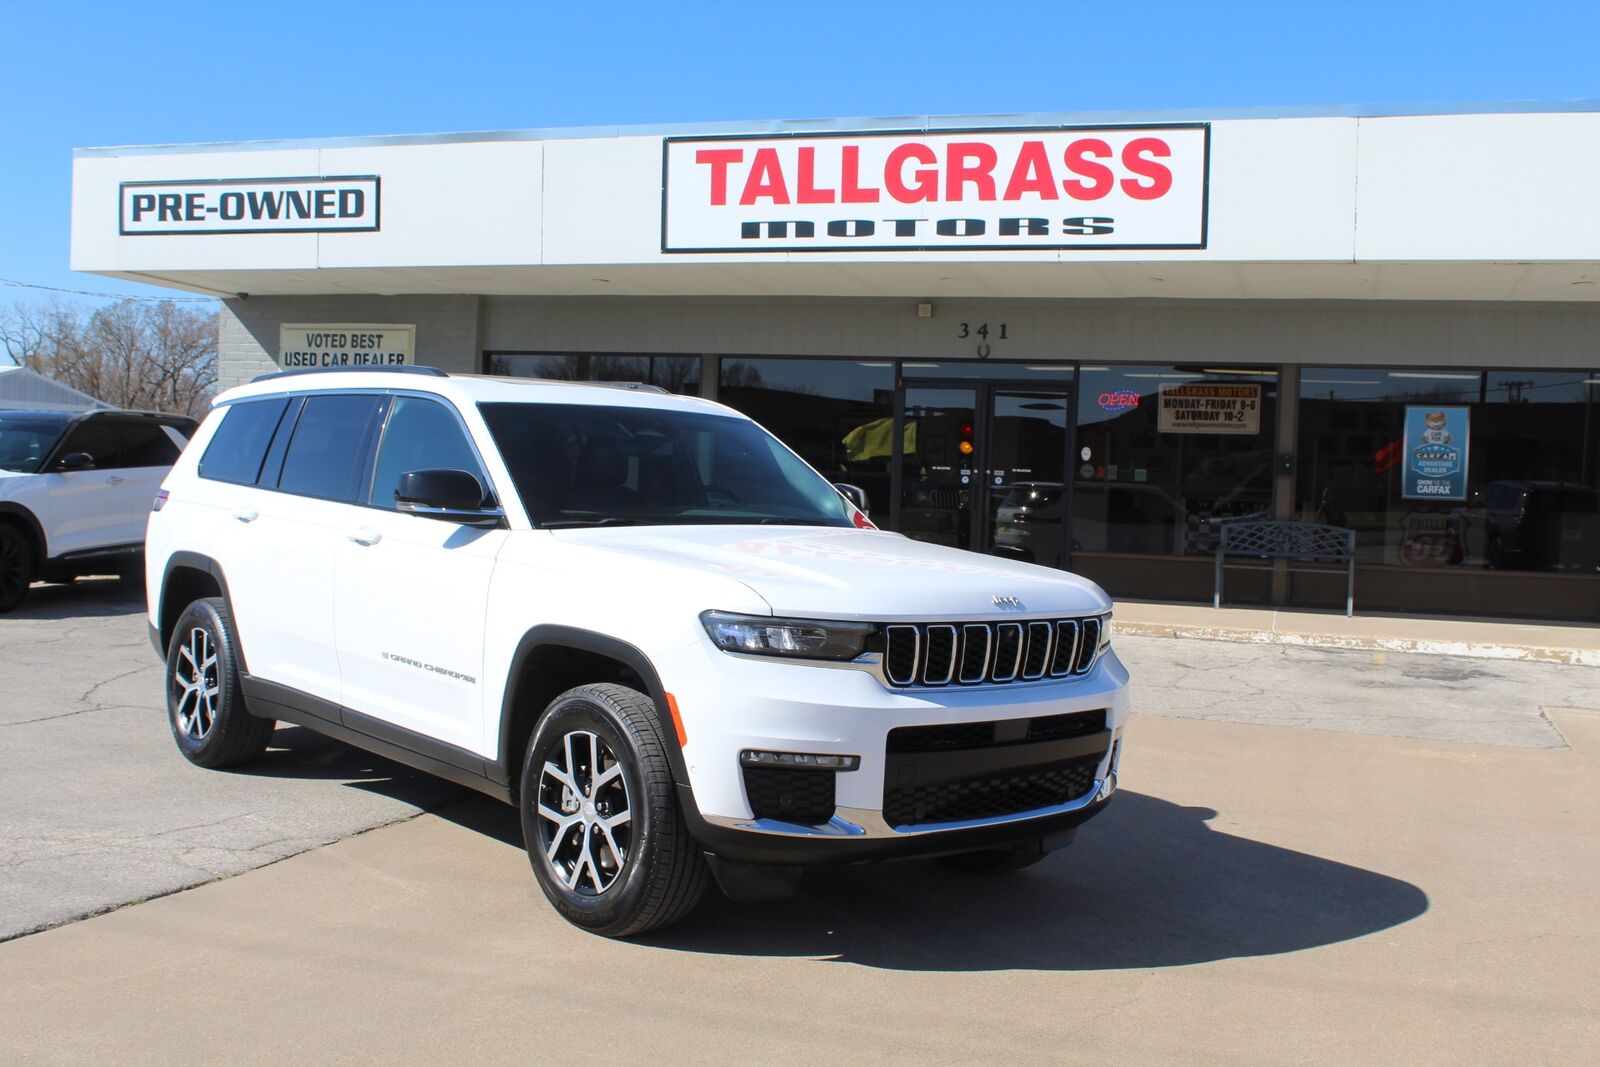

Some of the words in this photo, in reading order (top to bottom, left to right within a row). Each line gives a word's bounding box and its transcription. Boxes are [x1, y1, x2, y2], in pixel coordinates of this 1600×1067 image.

[695, 137, 1173, 206] TALLGRASS
[132, 189, 365, 222] PRE-OWNED
[957, 322, 1008, 340] 341
[306, 333, 347, 348] VOTED
[350, 334, 383, 349] BEST
[284, 352, 317, 366] USED
[321, 353, 349, 367] CAR
[353, 353, 405, 366] DEALER
[1164, 386, 1217, 397] TALLGRASS
[1219, 388, 1257, 398] MOTORS
[1097, 393, 1140, 407] OPEN
[1163, 398, 1237, 410] MONDAY-FRIDAY
[1240, 400, 1257, 410] 9-6
[1174, 410, 1221, 421] SATURDAY
[1223, 411, 1245, 422] 10-2
[1417, 485, 1450, 494] CARFAX
[991, 594, 1018, 607] Jeep
[390, 654, 422, 668] GRAND
